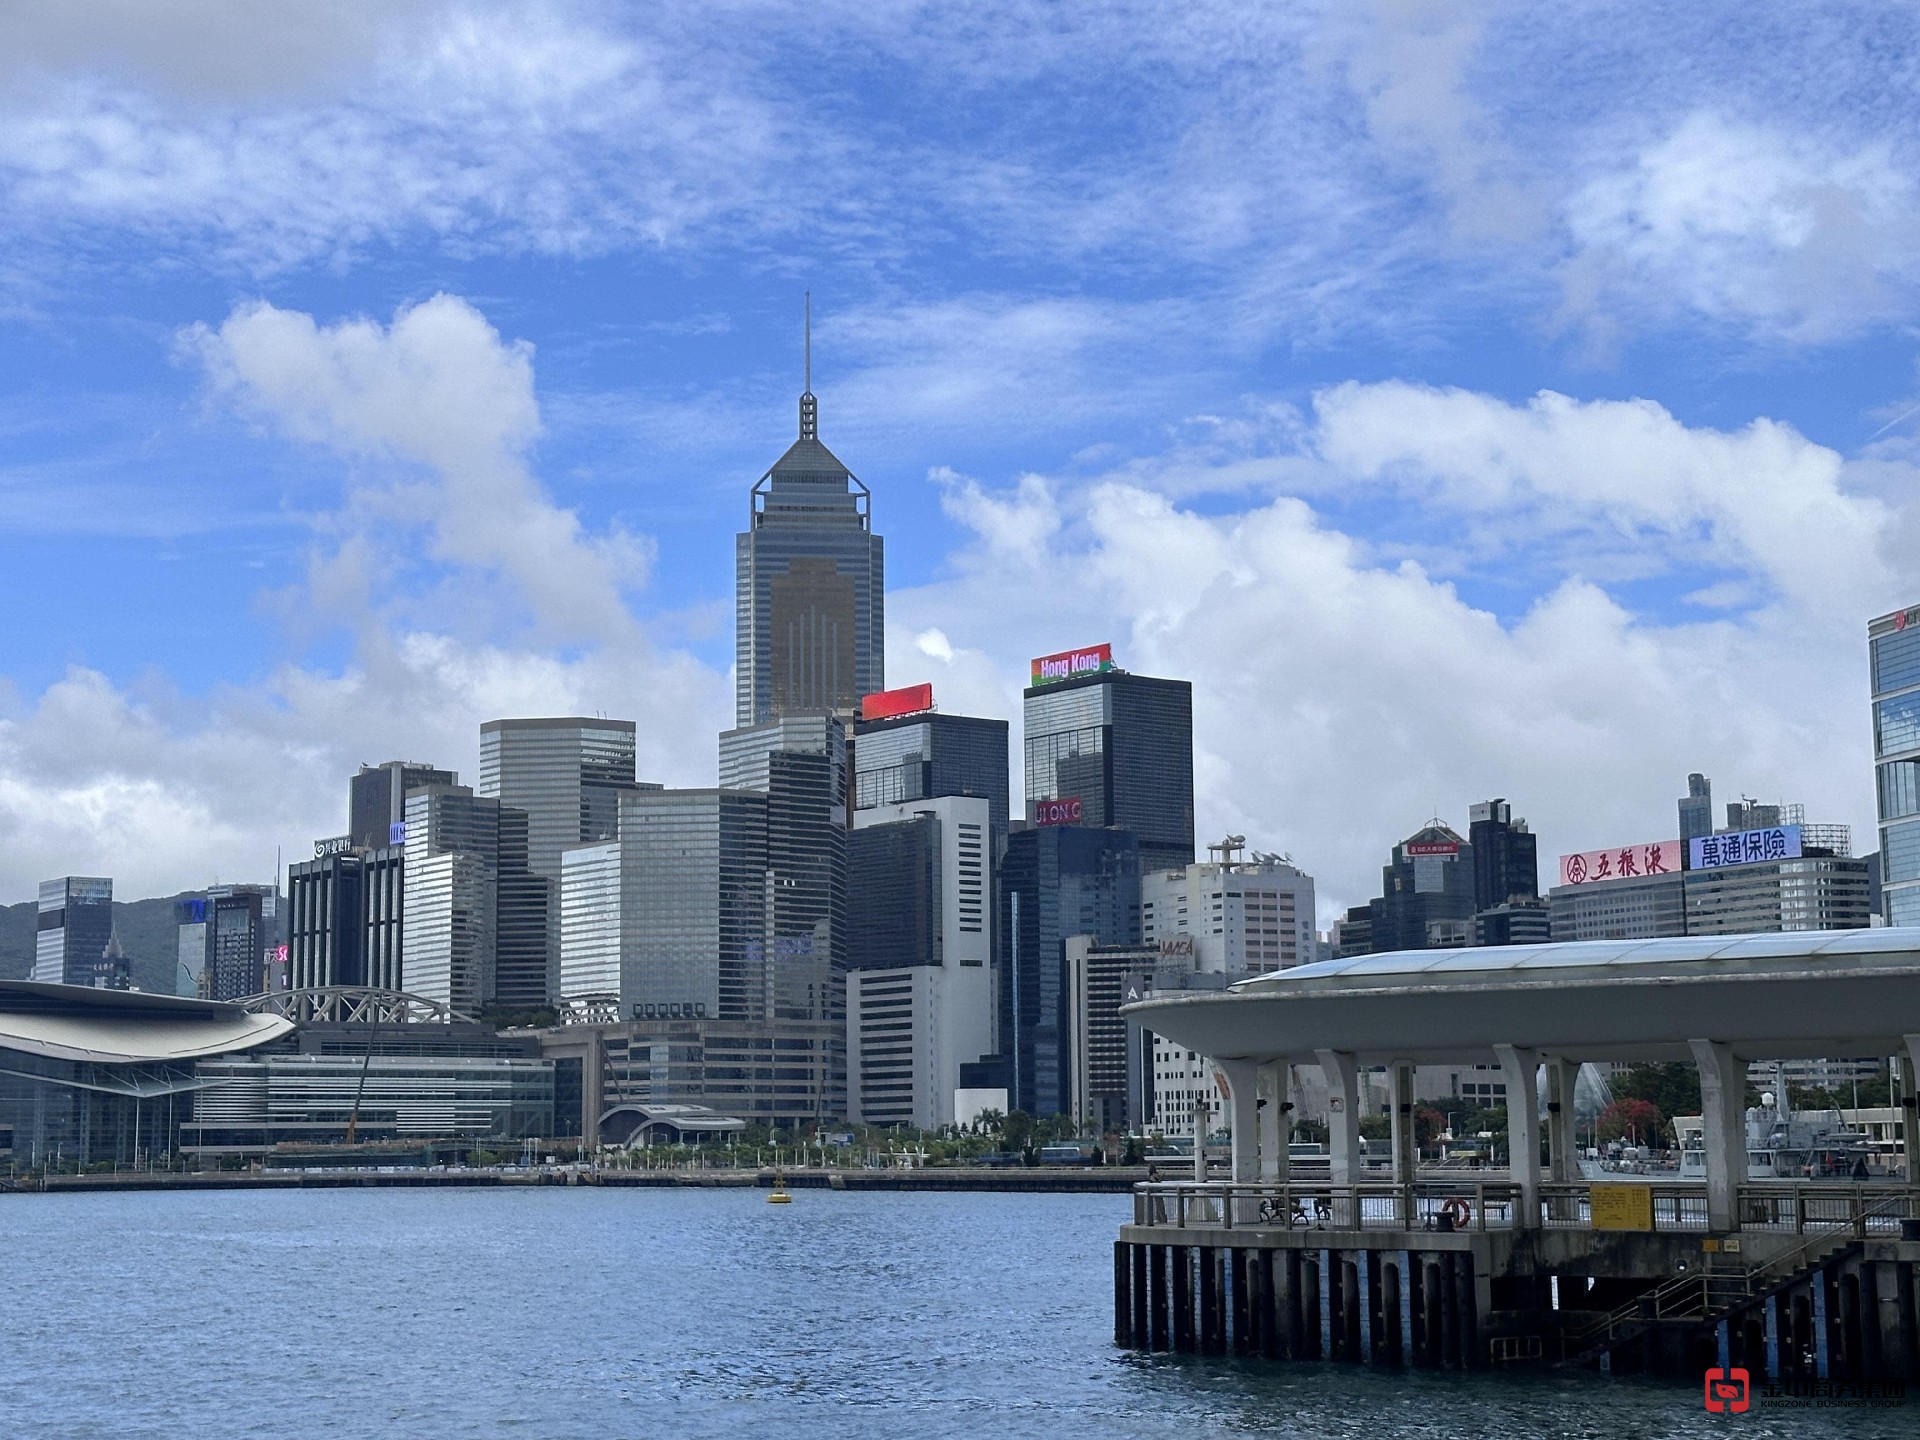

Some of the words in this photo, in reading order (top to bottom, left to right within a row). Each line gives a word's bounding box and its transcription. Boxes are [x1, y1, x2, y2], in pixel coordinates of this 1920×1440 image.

[1041, 659, 1068, 679] Hong
[1071, 652, 1100, 673] Kong
[1590, 843, 1669, 881] 五粮液
[1701, 829, 1786, 867] 萬通保險
